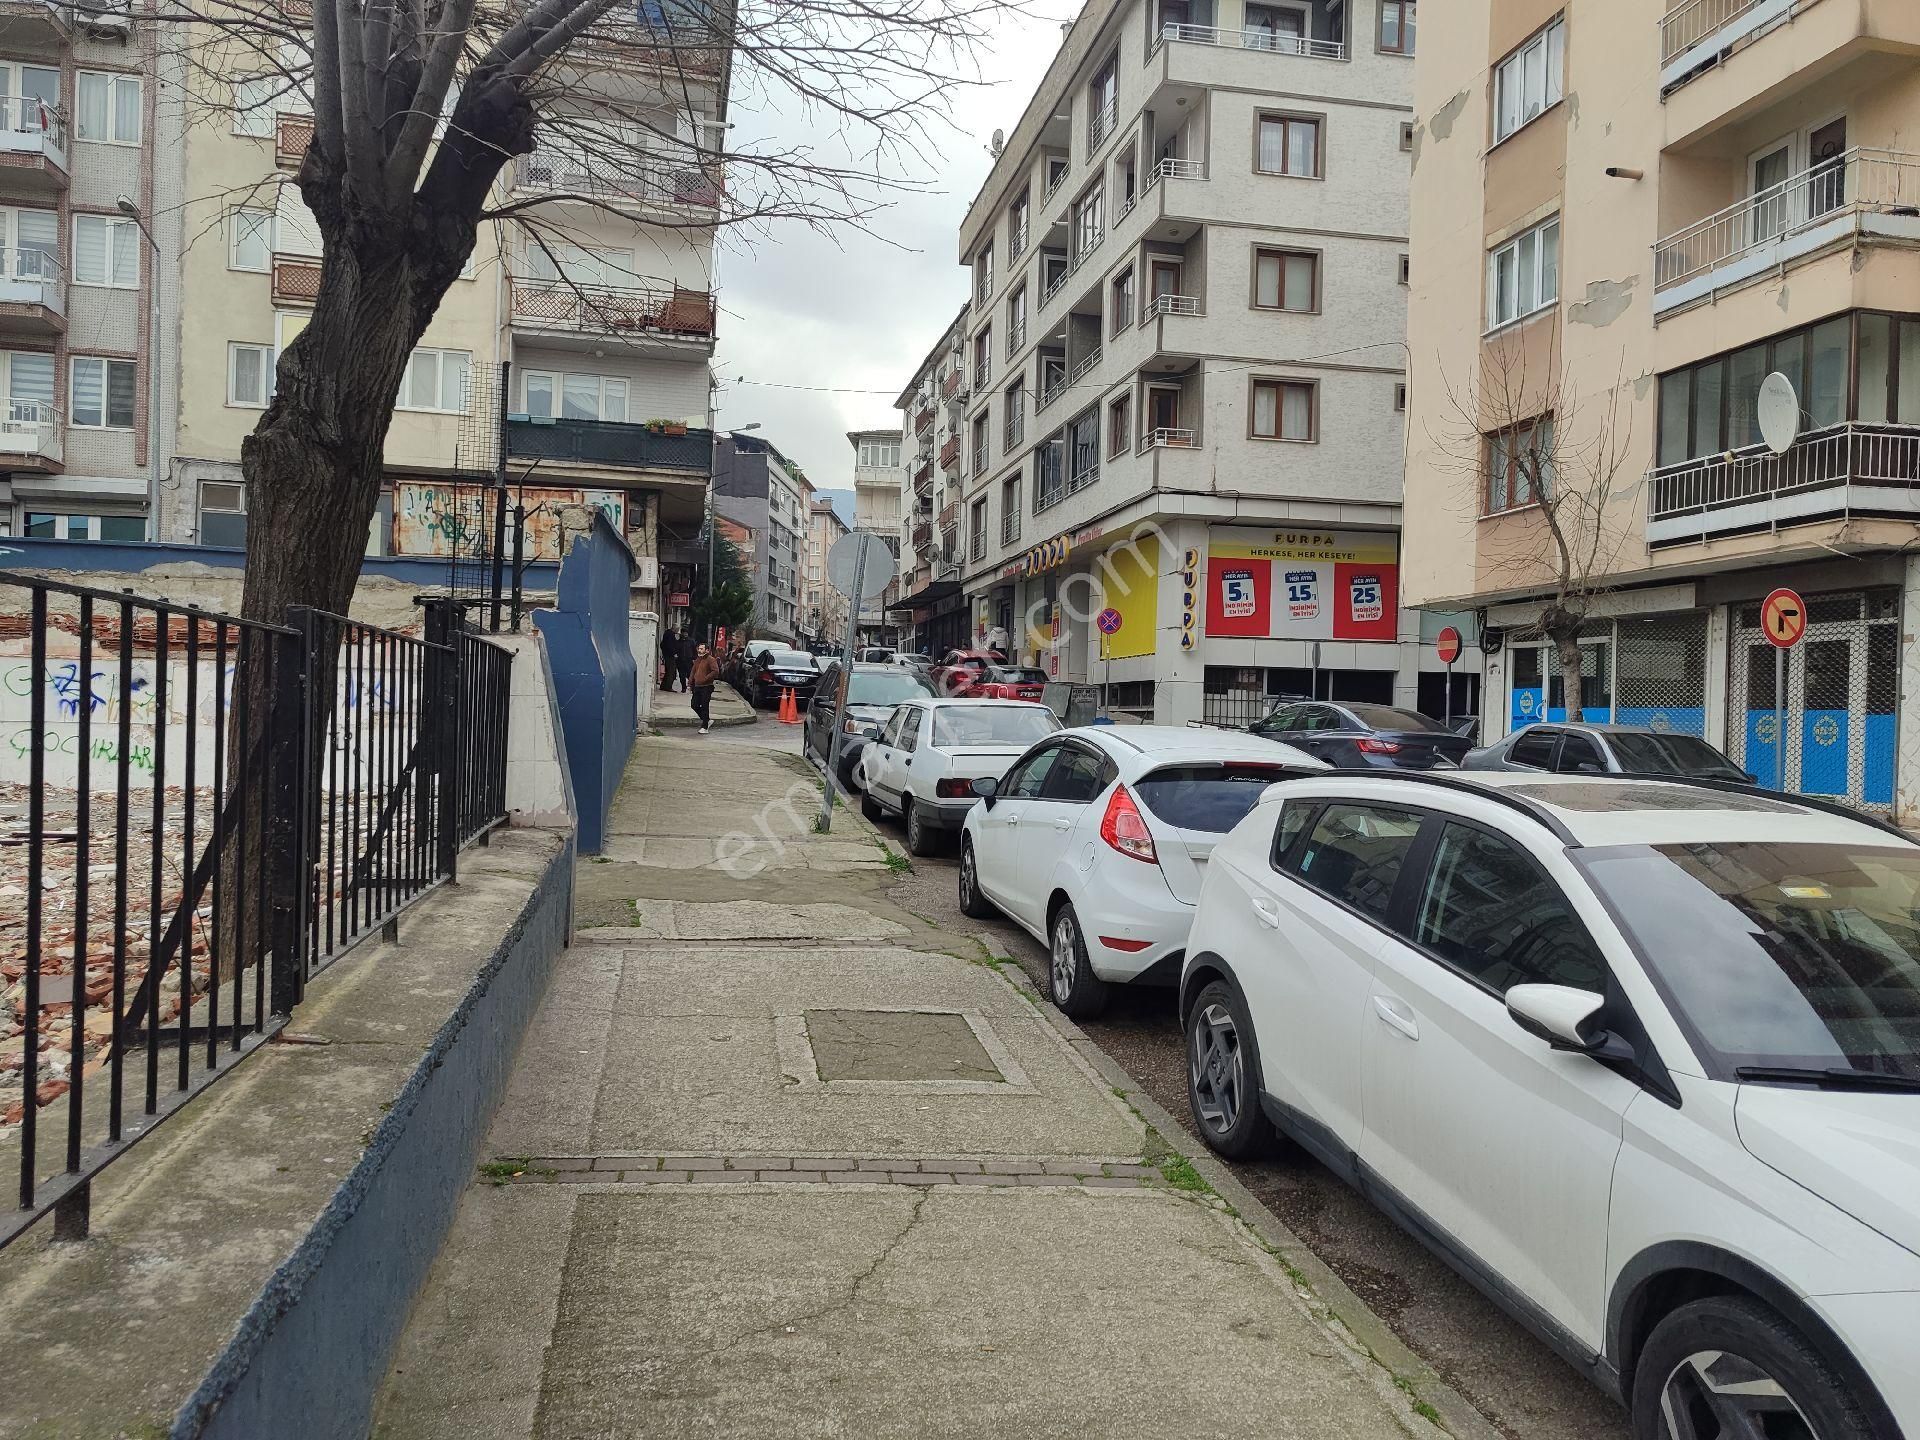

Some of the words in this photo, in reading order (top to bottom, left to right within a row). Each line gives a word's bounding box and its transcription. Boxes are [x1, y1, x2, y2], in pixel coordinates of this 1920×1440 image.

[1276, 534, 1334, 545] FURPA
[1250, 549, 1295, 559] HERKESE,
[1297, 551, 1316, 559] HER
[1318, 552, 1356, 560] KESEYE!
[1182, 550, 1197, 648] FURPA
